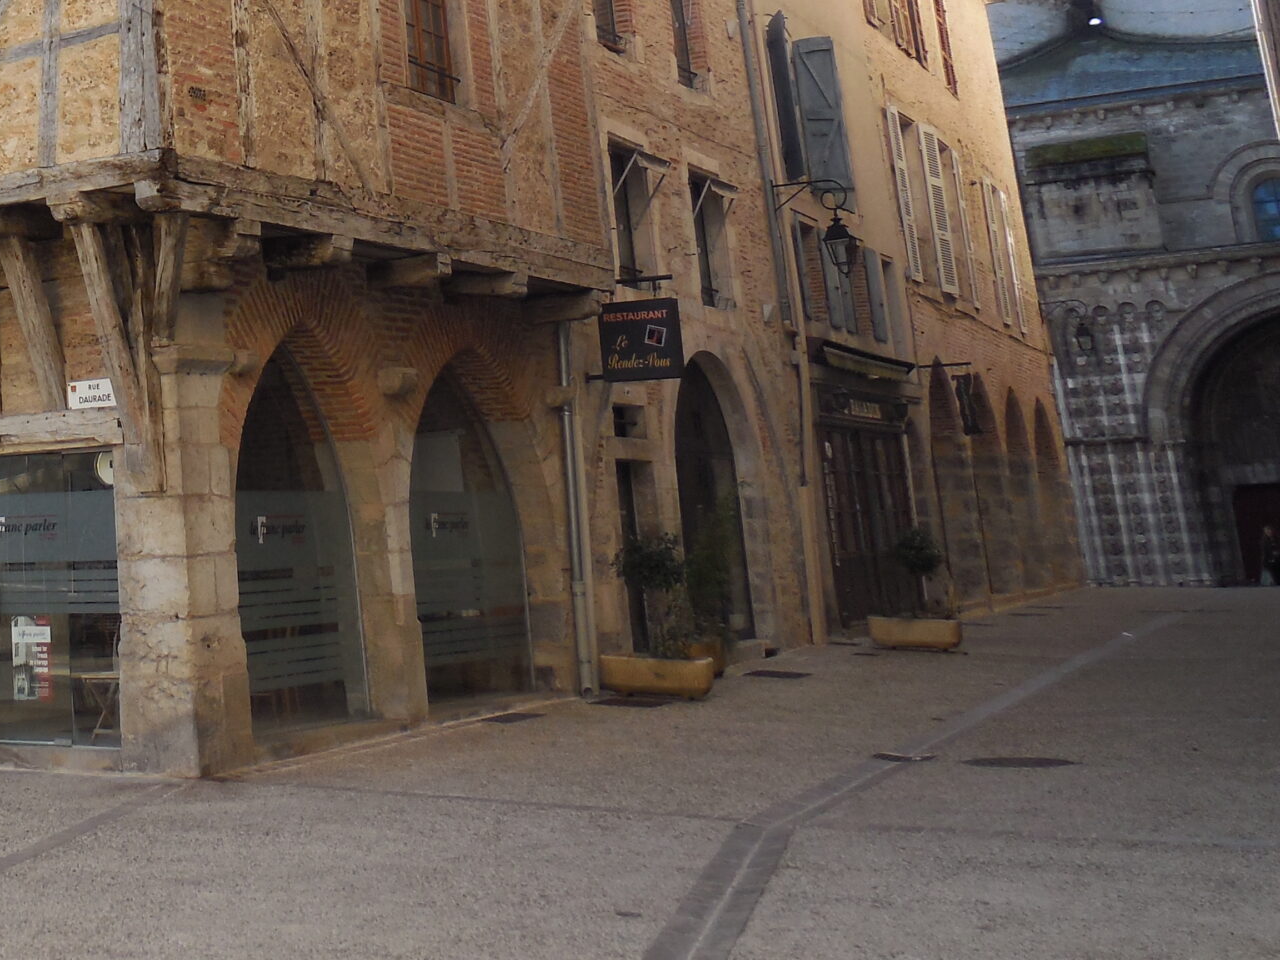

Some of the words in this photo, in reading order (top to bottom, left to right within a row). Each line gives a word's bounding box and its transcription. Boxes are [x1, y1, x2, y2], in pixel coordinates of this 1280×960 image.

[603, 309, 668, 322] RESTAURANT
[612, 335, 628, 351] Le
[608, 352, 671, 369] Rendez-Vous
[78, 393, 112, 404] DAURADE
[24, 518, 58, 536] parler
